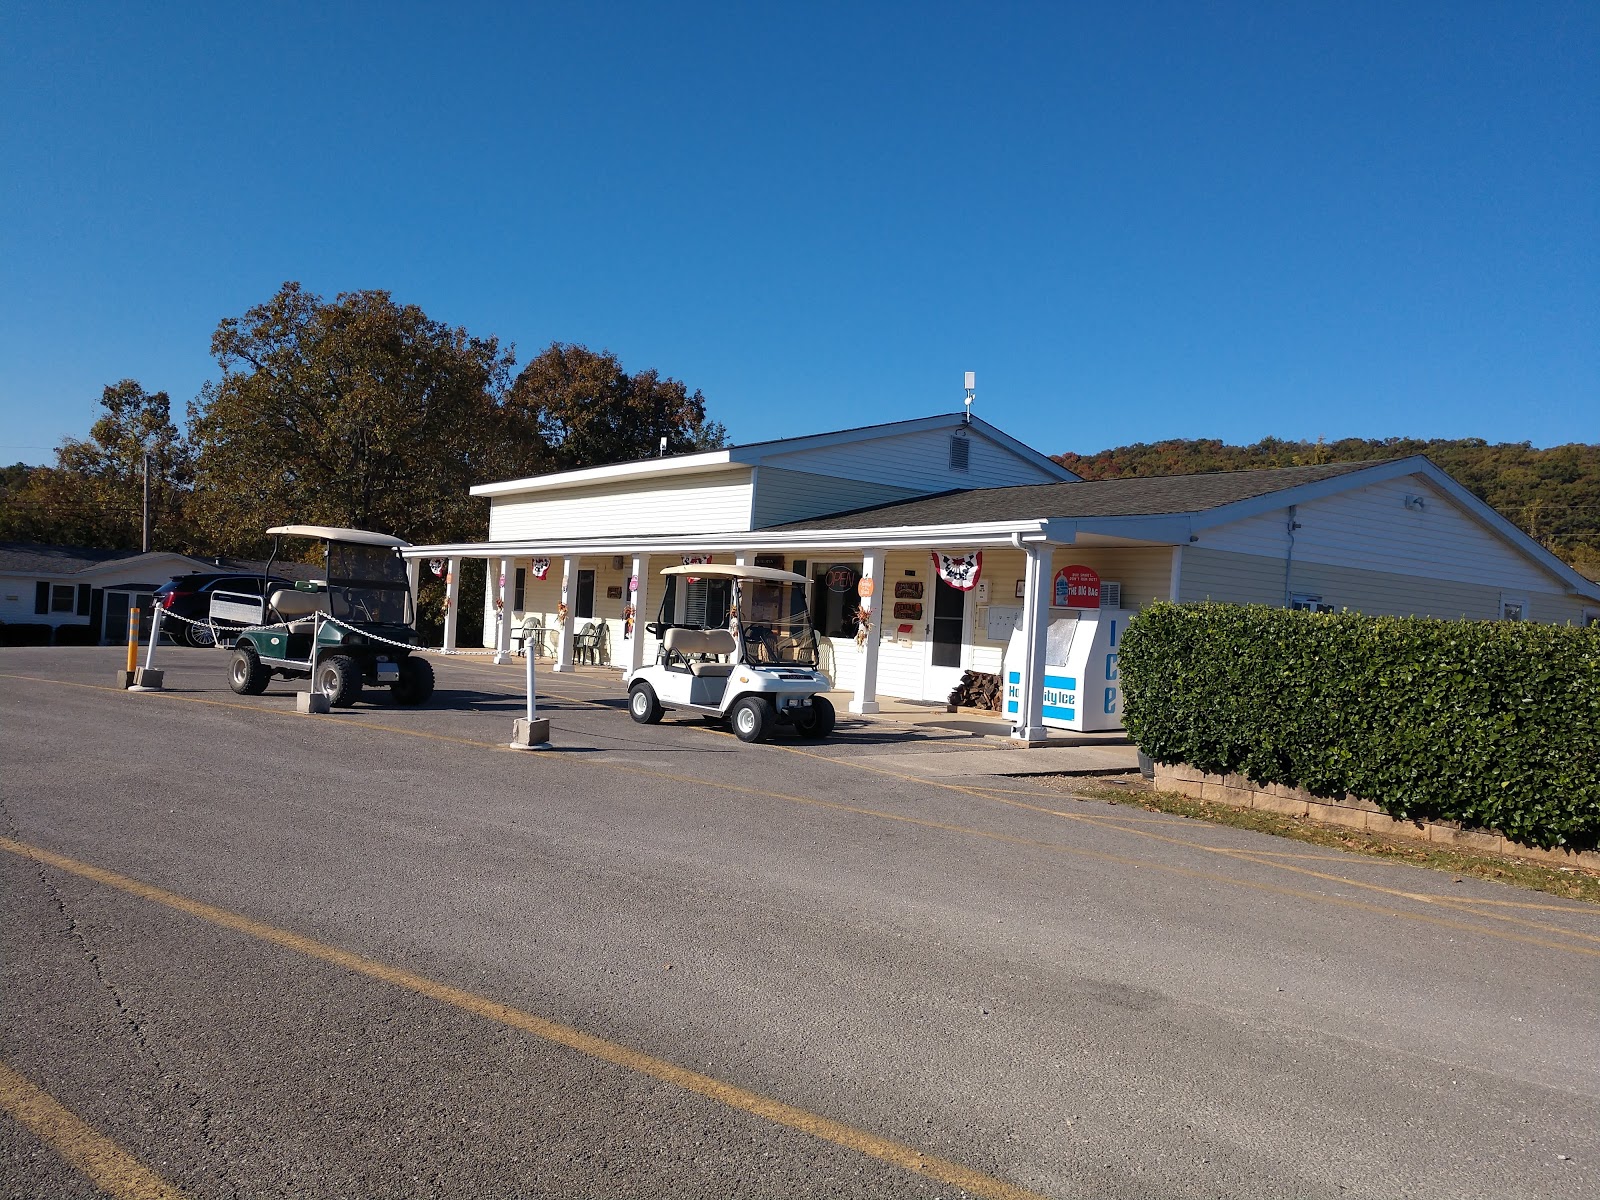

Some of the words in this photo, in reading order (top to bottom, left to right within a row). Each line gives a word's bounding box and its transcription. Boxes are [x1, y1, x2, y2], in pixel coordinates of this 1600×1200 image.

[826, 571, 854, 587] OPEN
[1068, 587, 1077, 596] THE
[1078, 585, 1087, 596] BIG
[1088, 587, 1099, 597] BAG
[1009, 685, 1019, 698] Ho
[1044, 690, 1057, 705] ity
[1058, 691, 1075, 704] Ice
